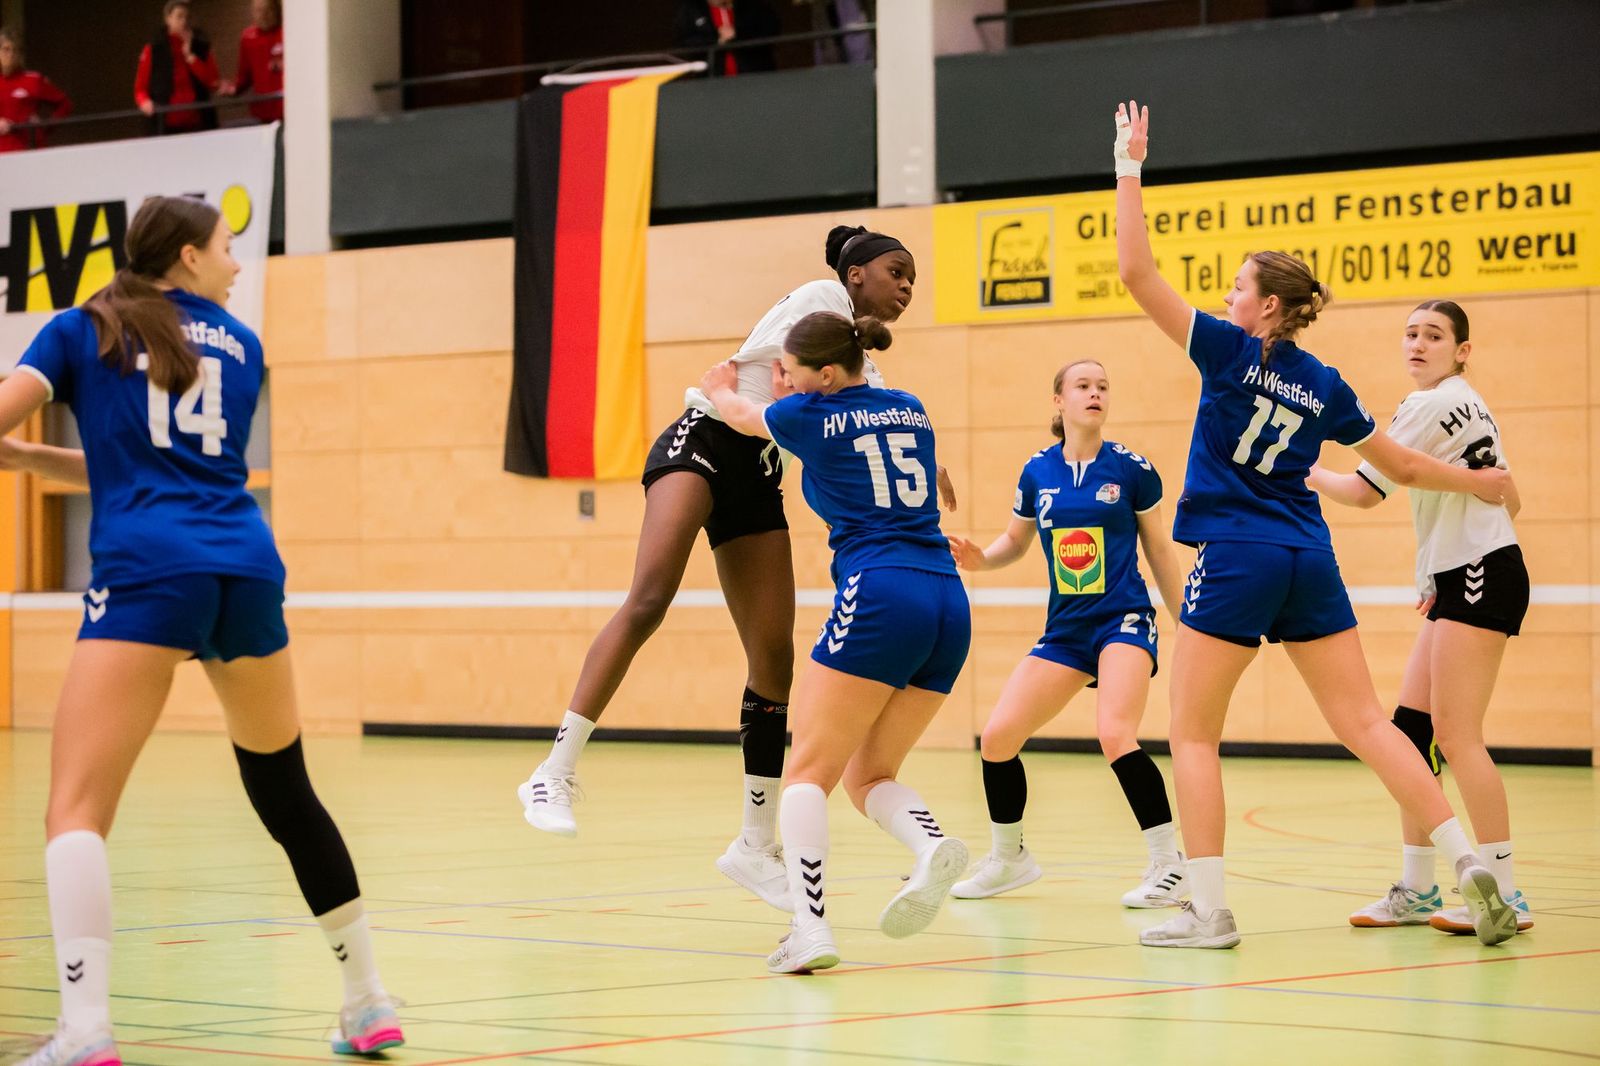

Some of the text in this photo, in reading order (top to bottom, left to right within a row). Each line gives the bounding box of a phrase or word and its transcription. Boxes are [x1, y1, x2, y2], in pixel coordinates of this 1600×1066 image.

[1245, 197, 1315, 228] und
[1334, 181, 1572, 221] Fensterbau
[1477, 231, 1577, 261] weru
[1180, 253, 1231, 292] Tel.
[135, 352, 228, 457] 14
[823, 406, 932, 439] HV Westfalen
[1439, 402, 1472, 436] HV
[1231, 394, 1304, 476] 17
[853, 432, 929, 509] 15
[1038, 493, 1054, 530] 2
[1060, 543, 1096, 557] COMPO
[1119, 612, 1141, 635] 2
